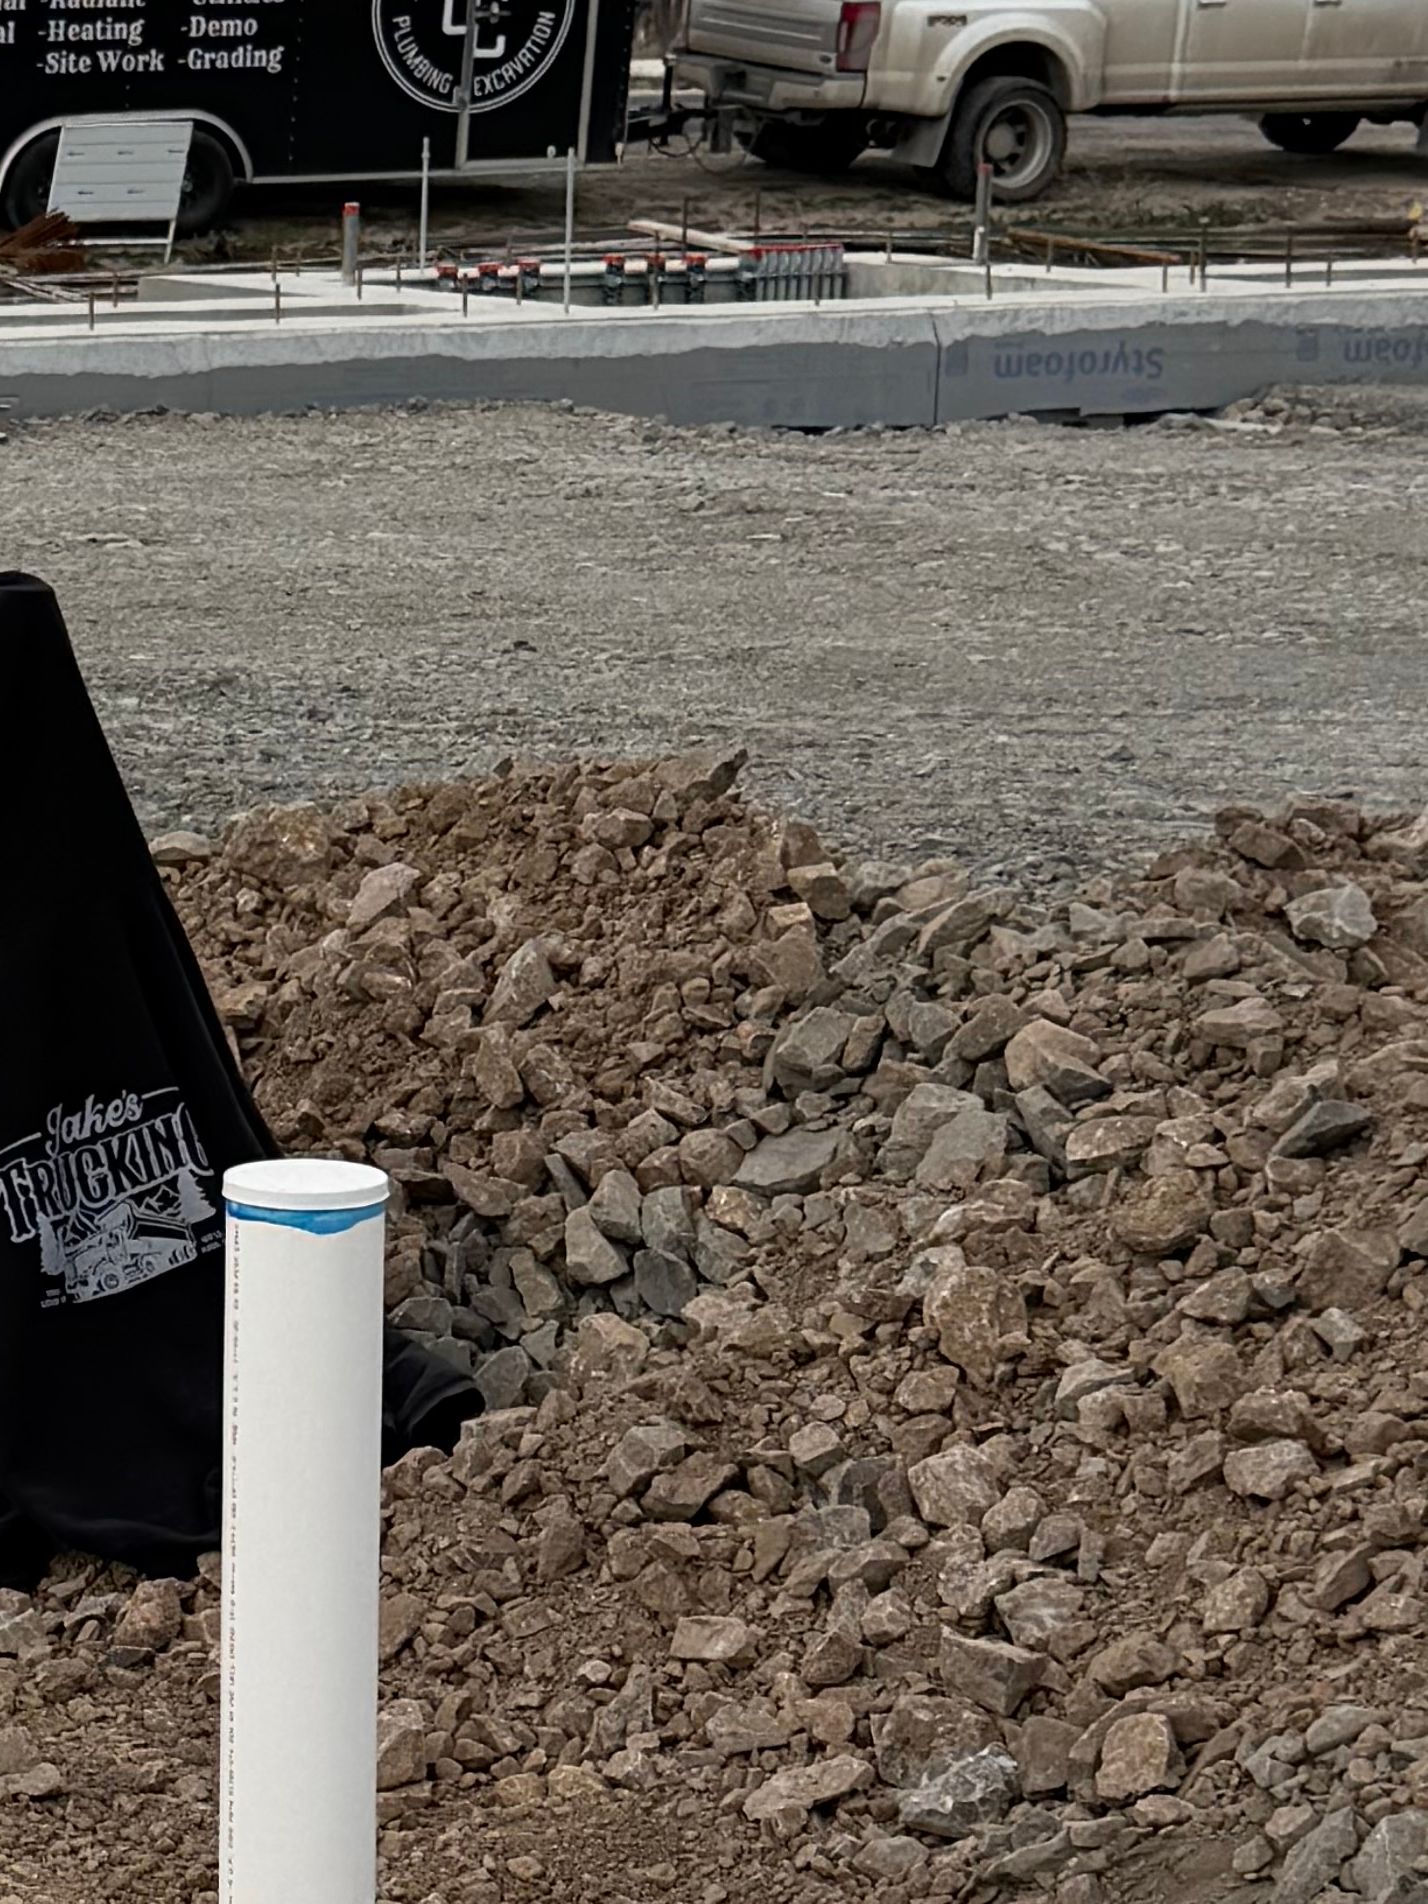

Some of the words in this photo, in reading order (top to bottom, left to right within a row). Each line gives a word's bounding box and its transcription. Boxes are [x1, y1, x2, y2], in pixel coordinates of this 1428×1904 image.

[38, 18, 144, 46] -Heating
[181, 15, 257, 38] -Demo
[36, 51, 92, 75] -Site
[96, 49, 164, 73] Work
[177, 45, 284, 74] -Grading
[393, 15, 455, 94] PLUMBING
[473, 11, 555, 96] EXCAVATION
[994, 340, 1164, 381] Styrofoam
[46, 1090, 143, 1157] Jake's
